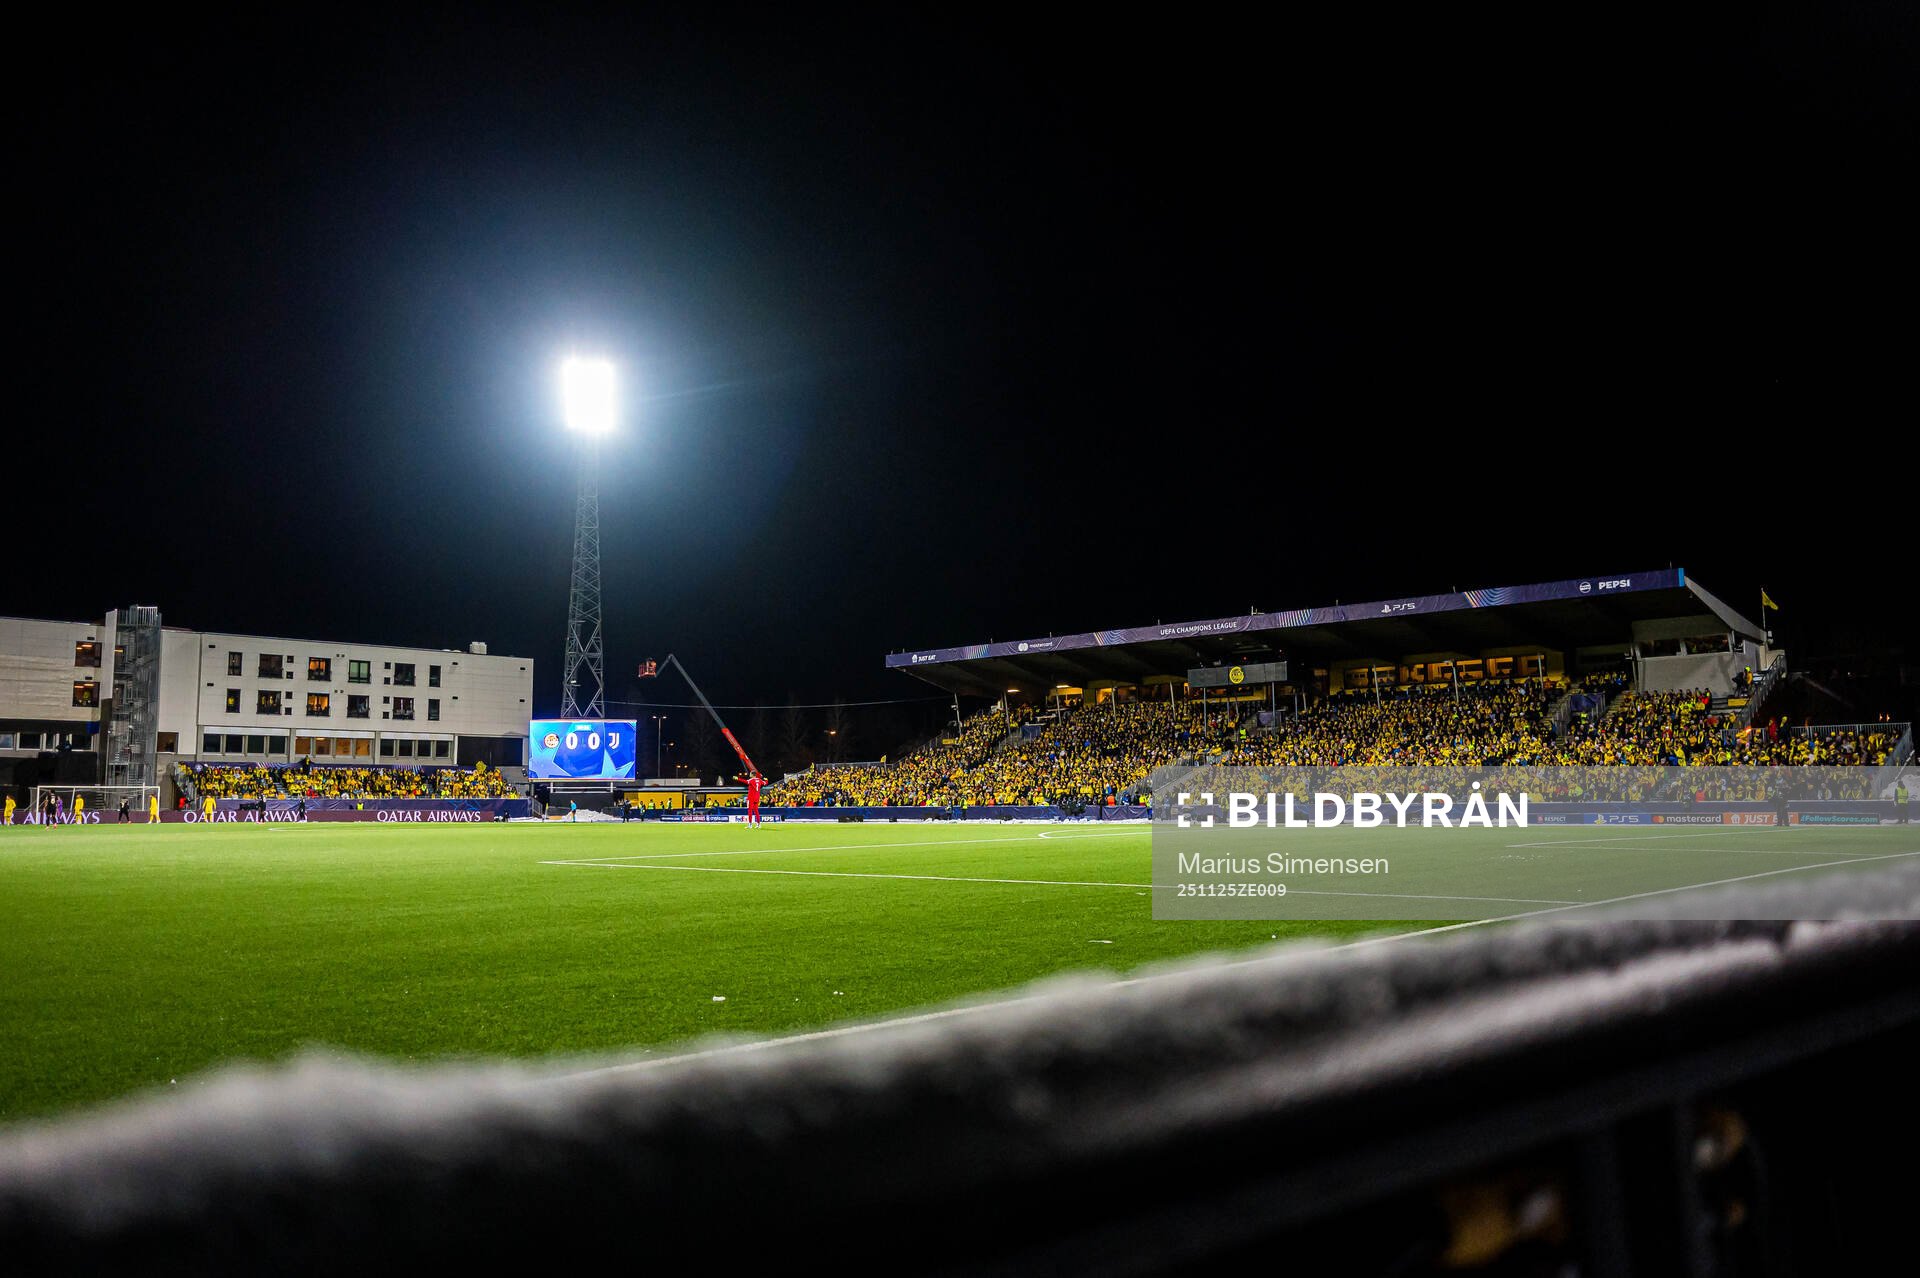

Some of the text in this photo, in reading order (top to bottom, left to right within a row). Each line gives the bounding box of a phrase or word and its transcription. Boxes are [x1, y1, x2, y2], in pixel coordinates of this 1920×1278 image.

[1598, 579, 1630, 590] PEPSI
[1392, 602, 1416, 611] PS5
[1160, 621, 1238, 636] UEFA CHAMPIONS LEAGUE
[565, 732, 600, 750] 0 0
[183, 810, 238, 823] QATAR
[376, 810, 481, 822] QATAR AIRWAYS
[1609, 815, 1639, 823] PS5
[1666, 814, 1722, 823] mastercard
[1744, 814, 1794, 823] JUST ET
